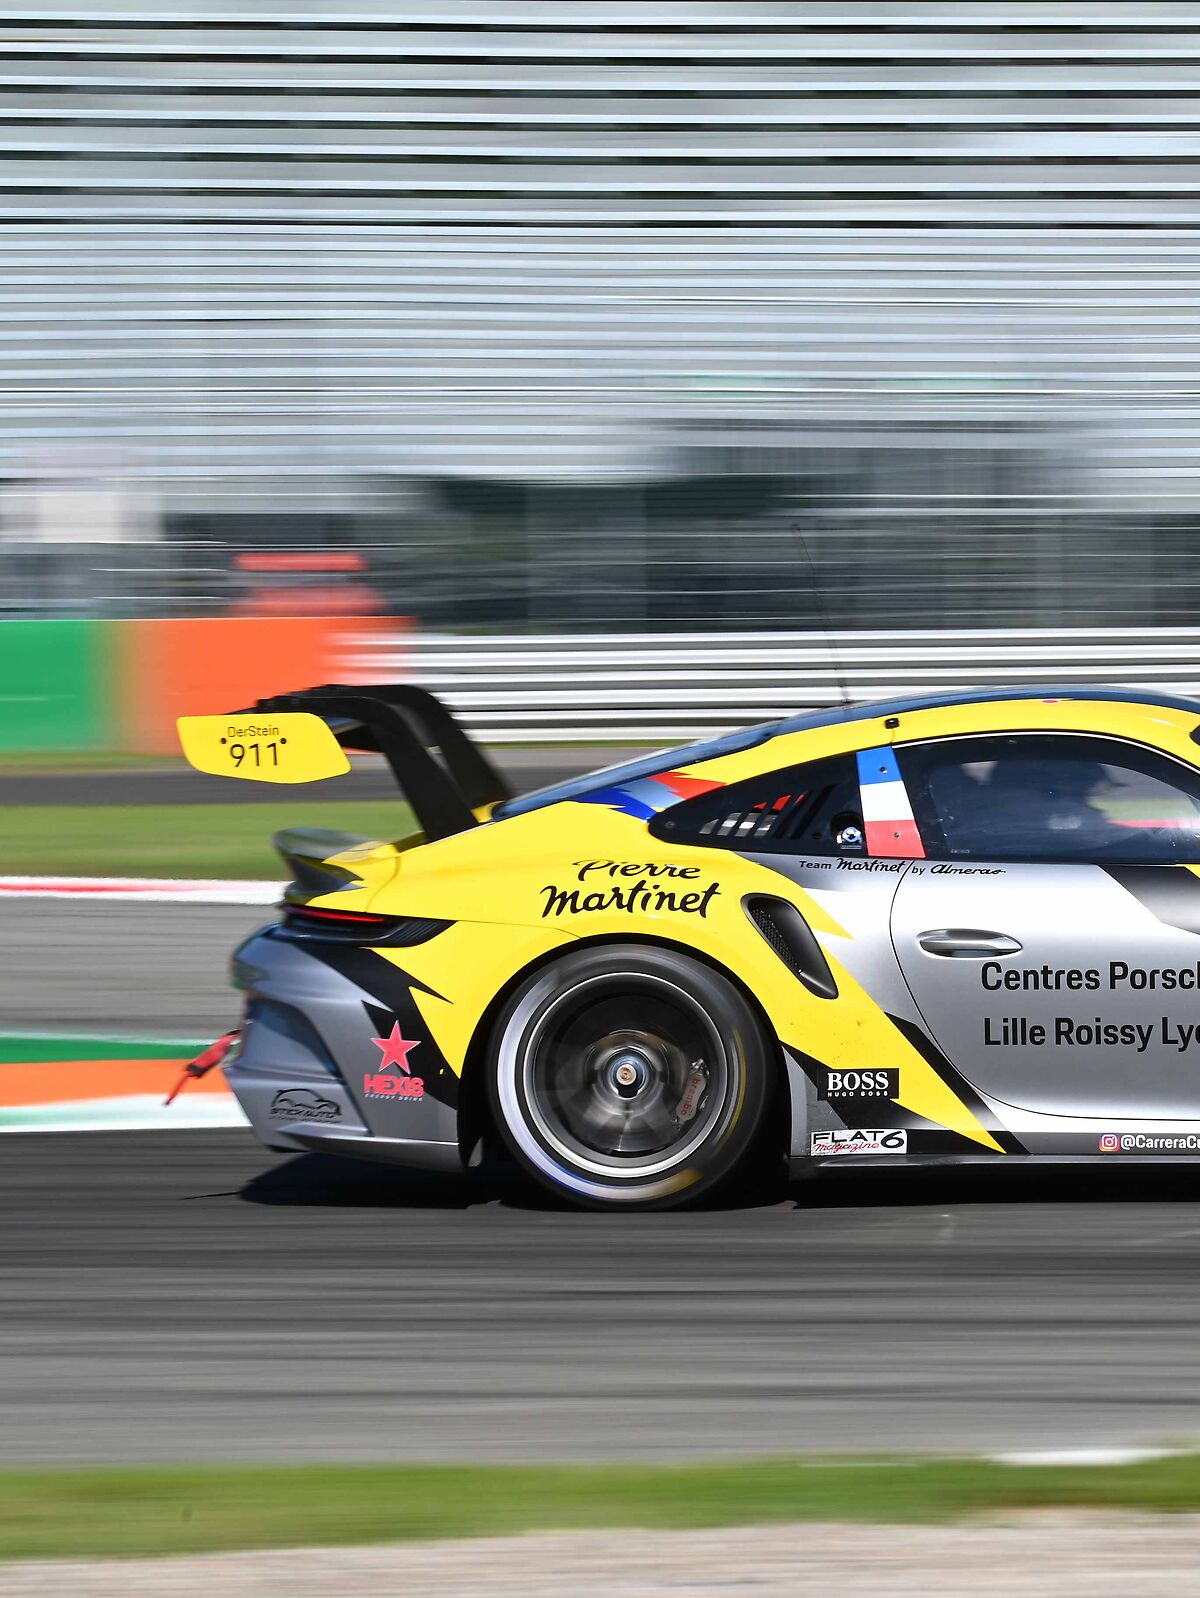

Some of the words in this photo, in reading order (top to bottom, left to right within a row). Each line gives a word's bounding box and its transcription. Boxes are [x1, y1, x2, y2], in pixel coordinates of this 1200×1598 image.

[227, 724, 280, 738] DerStein
[230, 742, 278, 768] 911
[572, 859, 701, 881] Pierre
[799, 860, 832, 870] Team
[836, 858, 906, 873] Martinet
[911, 866, 926, 875] by
[539, 879, 722, 918] Martinet
[981, 961, 1101, 991] Centres
[984, 1017, 1046, 1046] Lille
[1054, 1017, 1154, 1052] Roissy
[363, 1073, 424, 1098] HEXIS
[827, 1071, 889, 1091] BOSS
